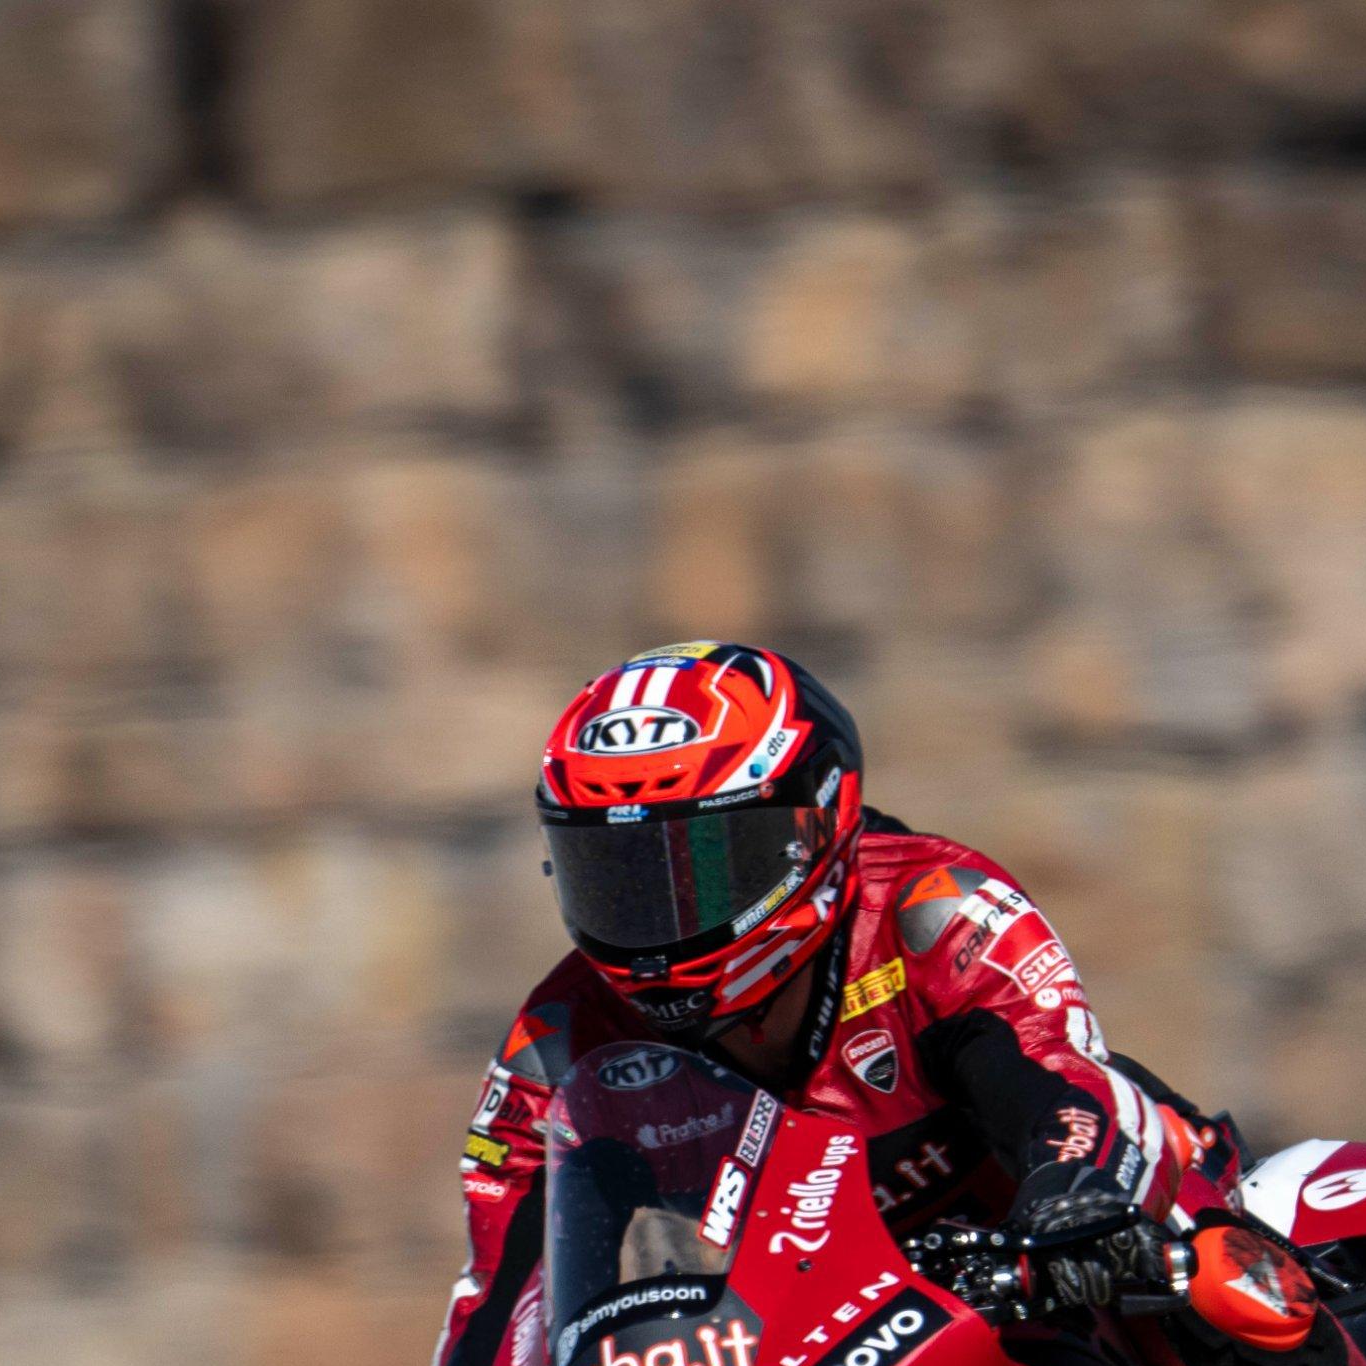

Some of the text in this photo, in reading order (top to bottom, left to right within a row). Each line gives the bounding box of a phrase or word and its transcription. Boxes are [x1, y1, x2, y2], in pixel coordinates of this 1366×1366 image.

[582, 712, 689, 752] KYT
[954, 887, 1029, 973] DAINES
[848, 1035, 888, 1060] DUCATI
[701, 1161, 747, 1247] WRS
[780, 1134, 859, 1229] riello ups
[579, 1285, 707, 1333] simyousoon
